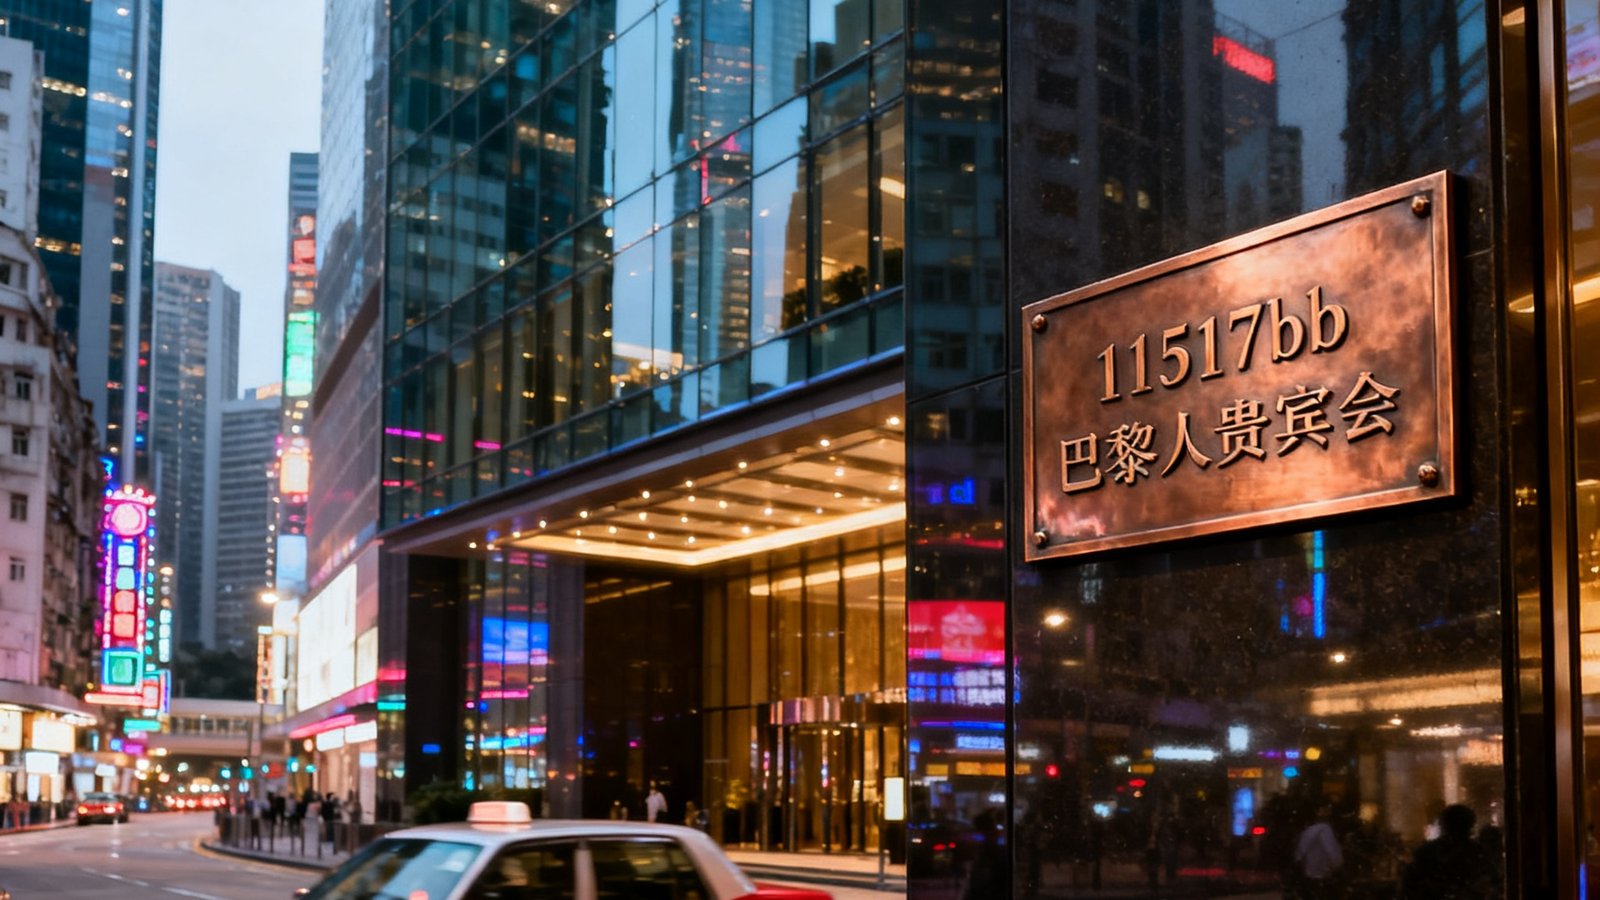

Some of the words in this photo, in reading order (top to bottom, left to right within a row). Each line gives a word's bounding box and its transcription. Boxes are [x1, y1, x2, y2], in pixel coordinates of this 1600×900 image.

[1097, 286, 1348, 402] 11517bb
[1060, 372, 1400, 492] 巴黎人贵宾会
